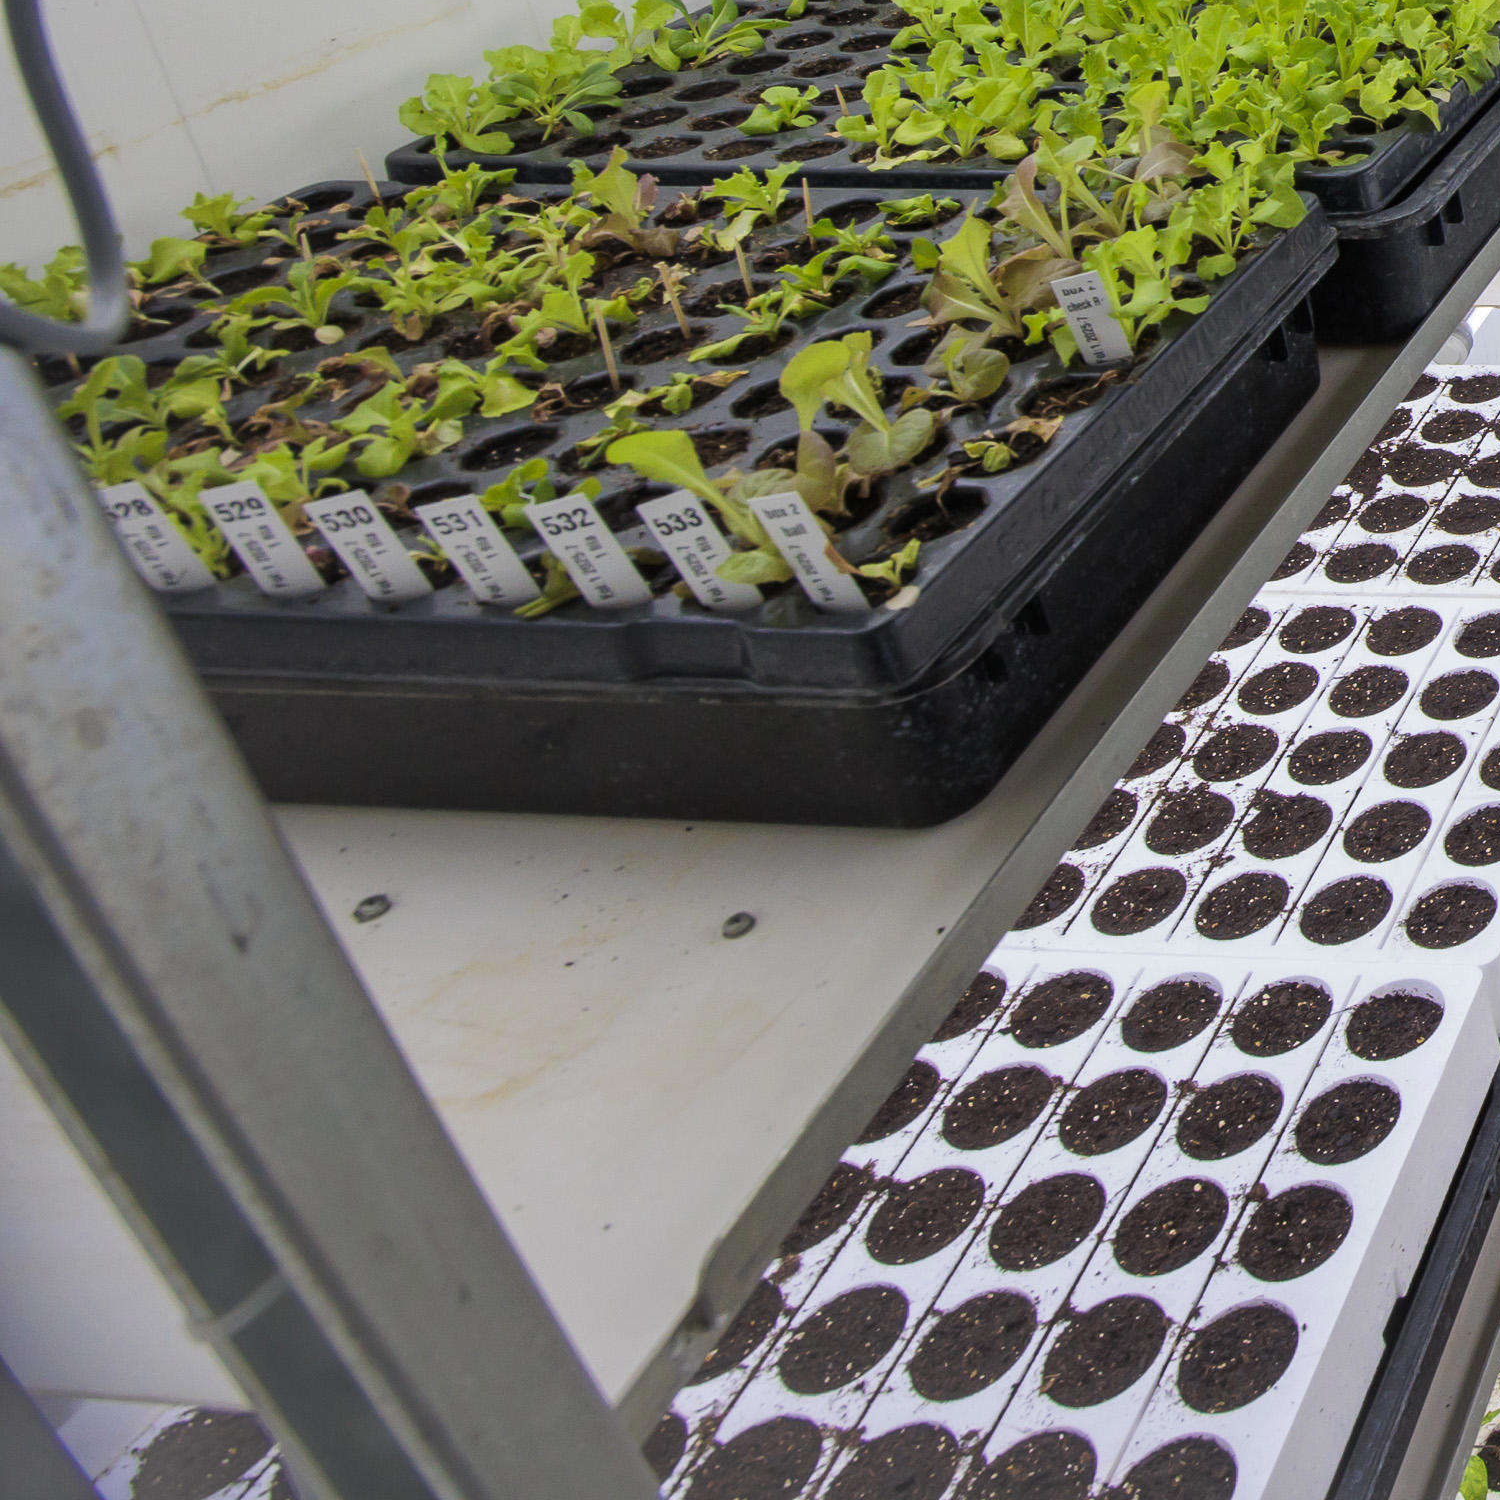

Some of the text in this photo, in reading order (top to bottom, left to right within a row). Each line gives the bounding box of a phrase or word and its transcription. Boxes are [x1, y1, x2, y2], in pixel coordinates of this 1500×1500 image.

[213, 497, 265, 523] 529
[320, 505, 375, 533] 530
[431, 509, 483, 535] 531
[540, 508, 594, 536] 532
[653, 507, 703, 536] 533
[790, 504, 800, 516] 2
